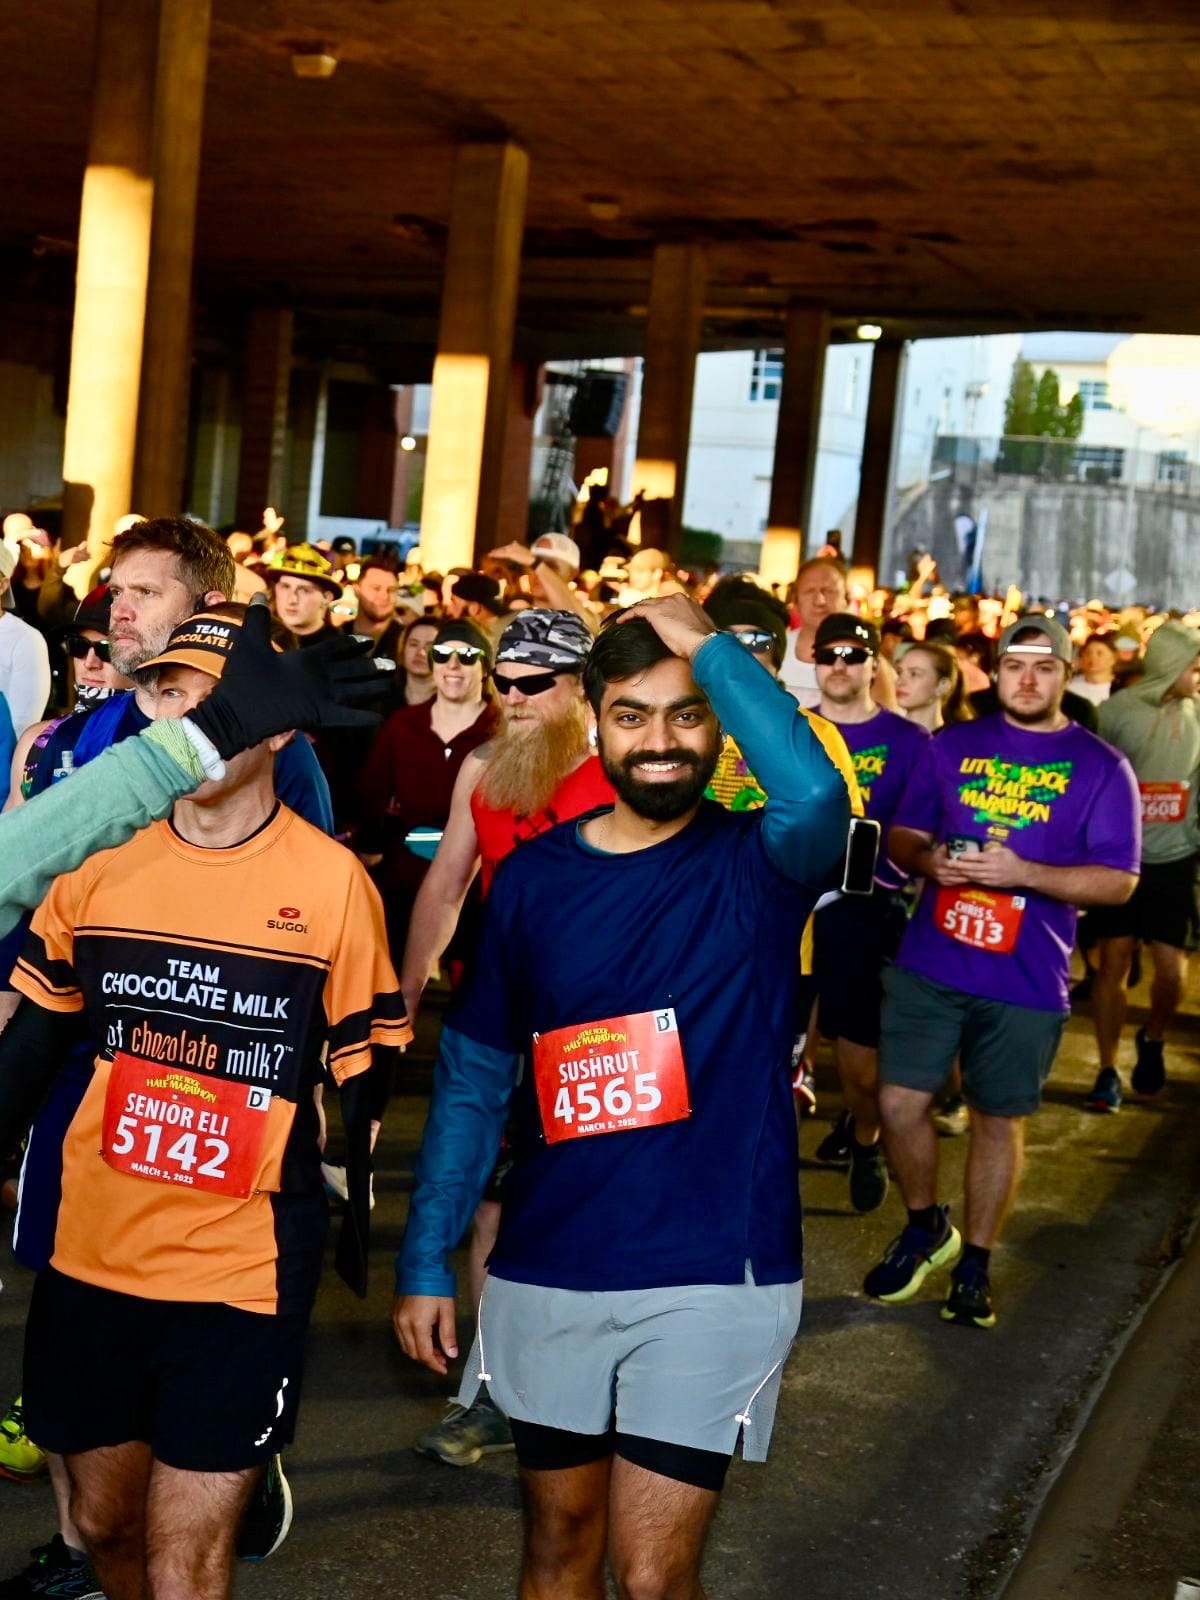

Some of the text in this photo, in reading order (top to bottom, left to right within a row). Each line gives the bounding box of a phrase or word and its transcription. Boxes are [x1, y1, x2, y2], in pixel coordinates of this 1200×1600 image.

[196, 624, 231, 638] TEAM
[986, 778, 1032, 800] HALF
[959, 788, 1052, 824] MARATHON
[943, 908, 1004, 945] 5113
[954, 900, 996, 922] CHRIS S.
[167, 958, 221, 985] TEAM
[101, 971, 291, 1020] CHOCOLATE MILK
[131, 1020, 219, 1071] chocolate
[226, 1041, 285, 1081] milk?
[562, 1032, 628, 1054] HALF MARATHON
[558, 1049, 641, 1085] SUSHRUT
[146, 1078, 217, 1104] HALF MARATHON
[553, 1071, 662, 1125] 4565
[124, 1092, 230, 1137] SENIOR ELI
[577, 1122, 606, 1134] MARCH
[617, 1117, 638, 1128] 2025
[112, 1115, 231, 1180] 5142
[130, 1162, 161, 1178] MARCH
[173, 1172, 195, 1185] 2025
